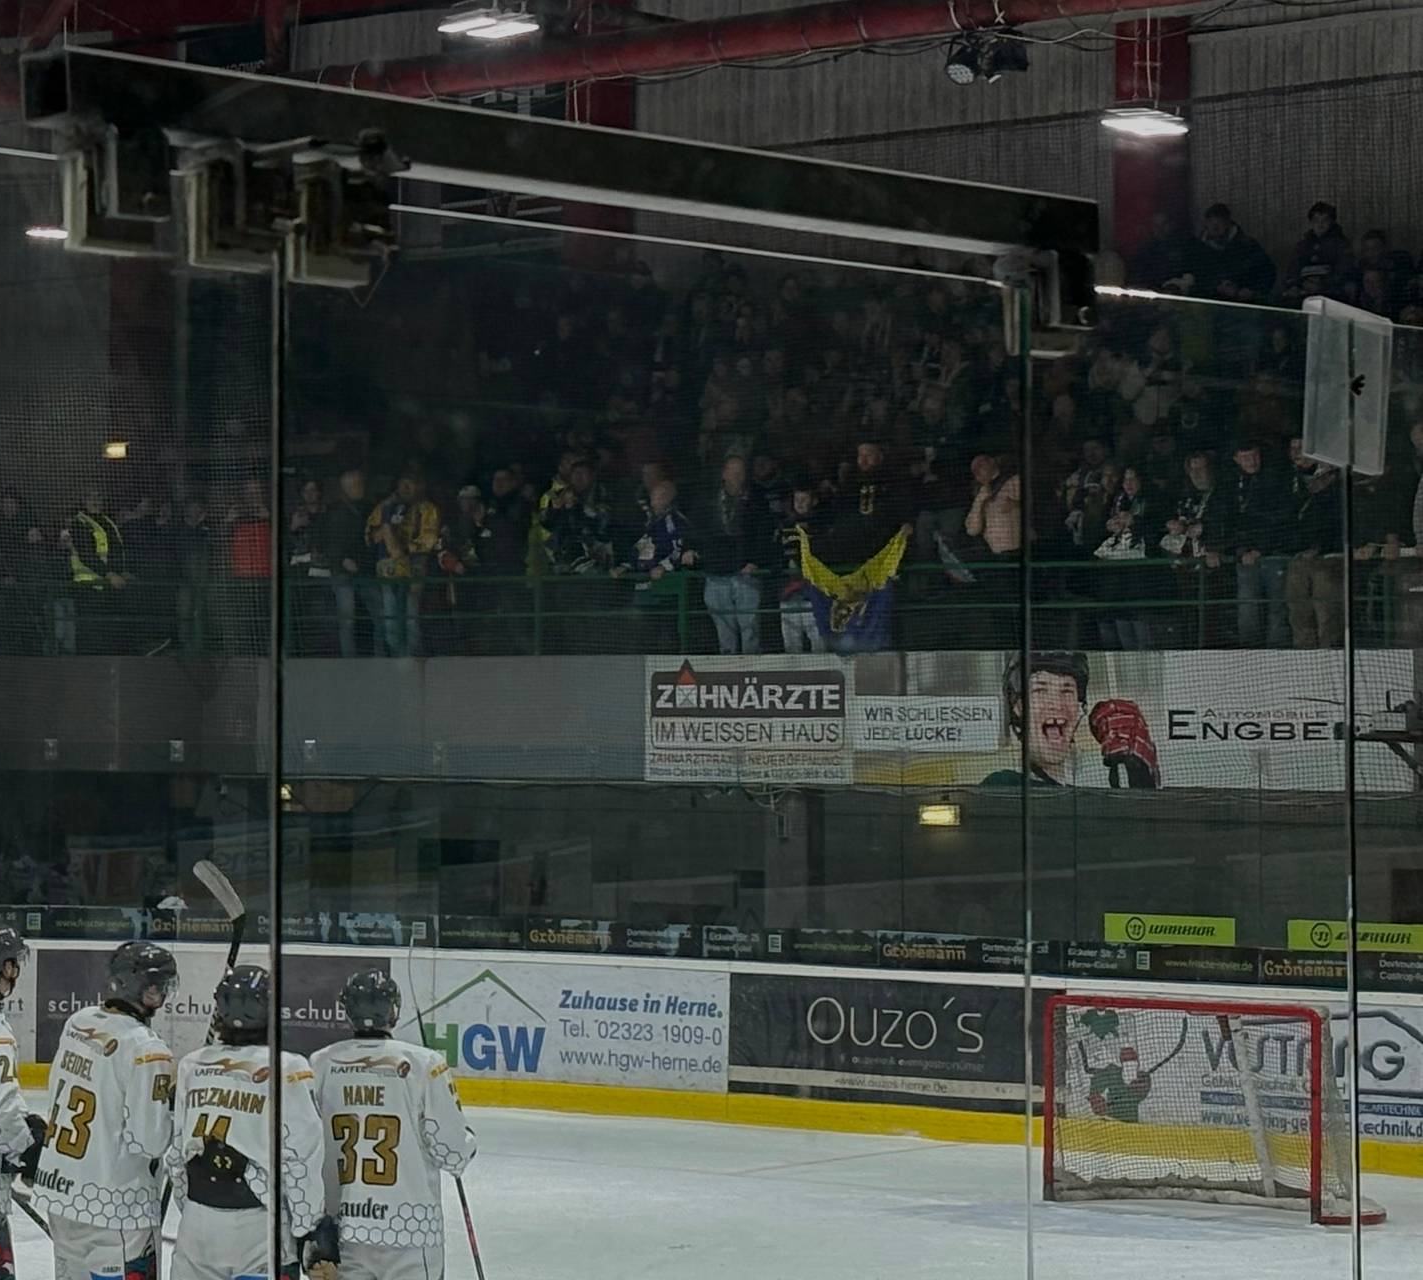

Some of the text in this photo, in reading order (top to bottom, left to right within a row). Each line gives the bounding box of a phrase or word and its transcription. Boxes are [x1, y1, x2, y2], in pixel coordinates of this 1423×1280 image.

[864, 706, 993, 722] WIR SCHLIESSEN
[655, 722, 840, 743] IM WEISSEN HAUS
[863, 723, 962, 741] JEDE LÜCKE!
[1263, 958, 1347, 979] Gröneman
[559, 989, 724, 1019] Zuhause in Herne.
[559, 1018, 723, 1046] Tel. 02323 1909-0
[426, 1021, 547, 1073] HGW
[60, 1050, 94, 1082] SEIDEL
[559, 1048, 723, 1074] www.hgw-herne.de
[343, 1085, 385, 1107] HANE
[331, 1113, 401, 1186] 33
